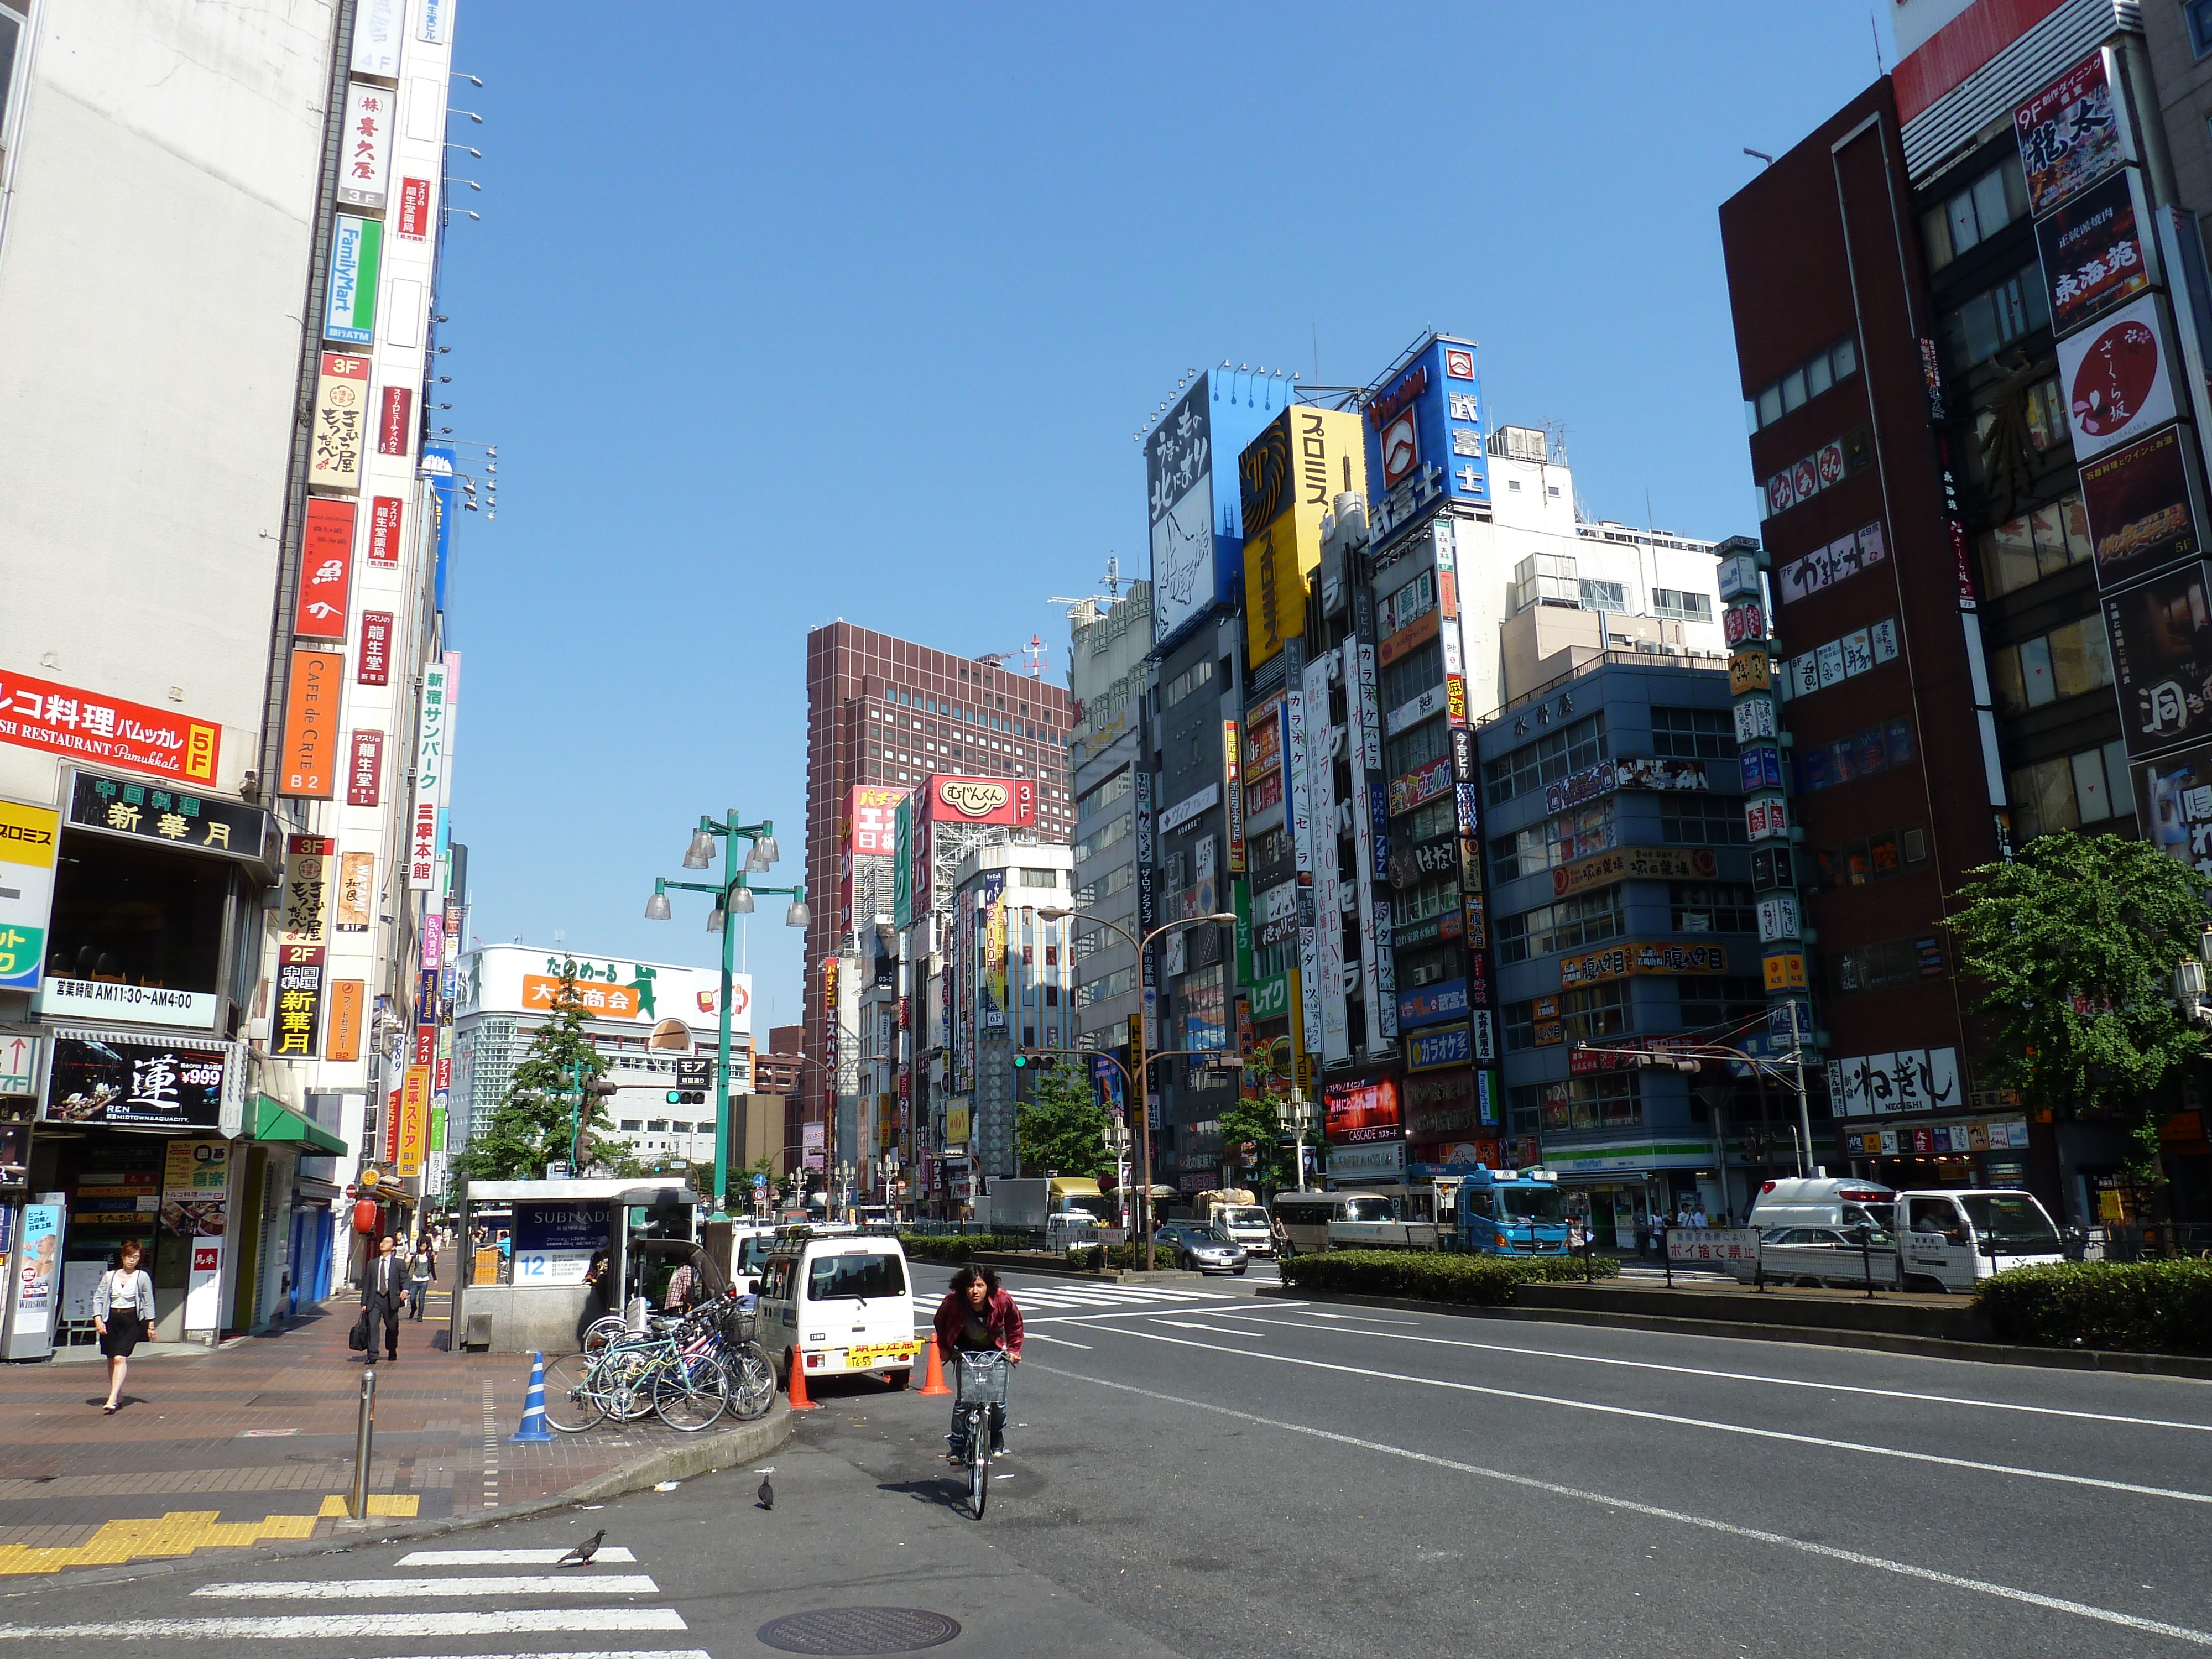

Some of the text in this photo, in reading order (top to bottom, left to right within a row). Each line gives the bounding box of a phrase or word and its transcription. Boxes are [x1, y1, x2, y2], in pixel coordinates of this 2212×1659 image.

[2018, 101, 2042, 131] 9F
[348, 190, 376, 204] 3F
[403, 186, 418, 233] 龍生堂薬局
[417, 181, 426, 206] クスリの
[335, 228, 359, 312] FamilyMart
[2056, 241, 2137, 307] 東海苑
[329, 328, 369, 341] 銀行ATM
[333, 358, 361, 374] 3F
[2100, 339, 2130, 423] さくら坂
[389, 388, 403, 455] スリムビューティハウス
[1448, 391, 1484, 493] 武富士
[1301, 413, 1329, 507] プロミス
[389, 500, 398, 528] クスリの
[1368, 460, 1443, 545] 武富士
[373, 507, 388, 558] 龍生堂薬局
[2175, 538, 2192, 554] 5F
[1780, 566, 1792, 577] 7F
[1260, 528, 1281, 651] プロミス
[365, 614, 390, 623] クスリの
[1358, 593, 1370, 637] 水上ビル
[366, 625, 385, 671] 龍生堂
[1288, 644, 1298, 685] 水上ビル
[1791, 656, 1802, 668] 6F
[1361, 648, 1375, 725] カラオケ
[1447, 679, 1464, 717] 麻雀
[304, 708, 320, 723] de
[1514, 692, 1574, 736] 水野屋
[21, 723, 112, 757] RESTAURANT
[116, 718, 184, 750] パムッカレ
[191, 732, 210, 771] 5F
[356, 743, 376, 787] 龍生堂
[1455, 732, 1469, 780] 今宮ビル
[413, 672, 444, 879] 新宿サンパーク 三平本館
[1290, 695, 1309, 865] カラオケ パセラ
[95, 779, 201, 817] 中国料理
[947, 785, 1003, 802] むじんくん
[1019, 786, 1031, 818] 3F
[1391, 780, 1404, 813] 麻雀
[107, 801, 231, 850] 新華月
[915, 786, 927, 895] アコム
[1177, 820, 1198, 836] SQUARE
[300, 840, 325, 854] 3F
[1375, 834, 1386, 872] 747
[1140, 868, 1152, 924] ザ・ロックアップ
[343, 924, 361, 932] B1F
[1237, 915, 1248, 949] レイク
[1468, 911, 1485, 948] 腹八分目
[1762, 908, 1773, 936] ねぎし
[1782, 905, 1794, 934] ねぎし
[290, 947, 315, 962] 2F
[1142, 943, 1154, 985] 北の家族
[1380, 928, 1392, 974] ダーツ
[1581, 950, 1625, 982] 腹八分目
[1663, 946, 1724, 971] 腹八分目
[546, 956, 618, 983] たのめーる
[1304, 953, 1317, 1000] ダーツ
[56, 980, 94, 998] 営業時間
[1252, 980, 1286, 1014] レイク
[278, 990, 317, 1053] 新華月
[340, 997, 351, 1050] フットセラピー
[826, 965, 837, 1068] パチンコ エスパス
[990, 1013, 1001, 1023] 6F
[420, 1035, 430, 1063] クスリ
[1241, 1032, 1253, 1055] 麻雀
[1421, 1035, 1457, 1058] カラオケ
[1477, 1011, 1491, 1057] 水野屋酒店
[439, 1060, 448, 1087] アイフル
[680, 1060, 705, 1073] モア
[1296, 1054, 1309, 1095] プロミス
[1854, 1055, 1953, 1108] ねぎし
[1479, 1073, 1489, 1116] FamilyMart
[1844, 1074, 1854, 1100] 新宿
[224, 1107, 239, 1125] B1
[404, 1077, 420, 1149] 三平ストア
[1885, 1100, 1923, 1111] NEGISHI
[1349, 1129, 1376, 1141] CASCADE
[1915, 1130, 1928, 1151] 大陸
[520, 1255, 545, 1275] 12
[1670, 1244, 1755, 1260] ポイ捨て禁止
[19, 1298, 48, 1310] Winston
